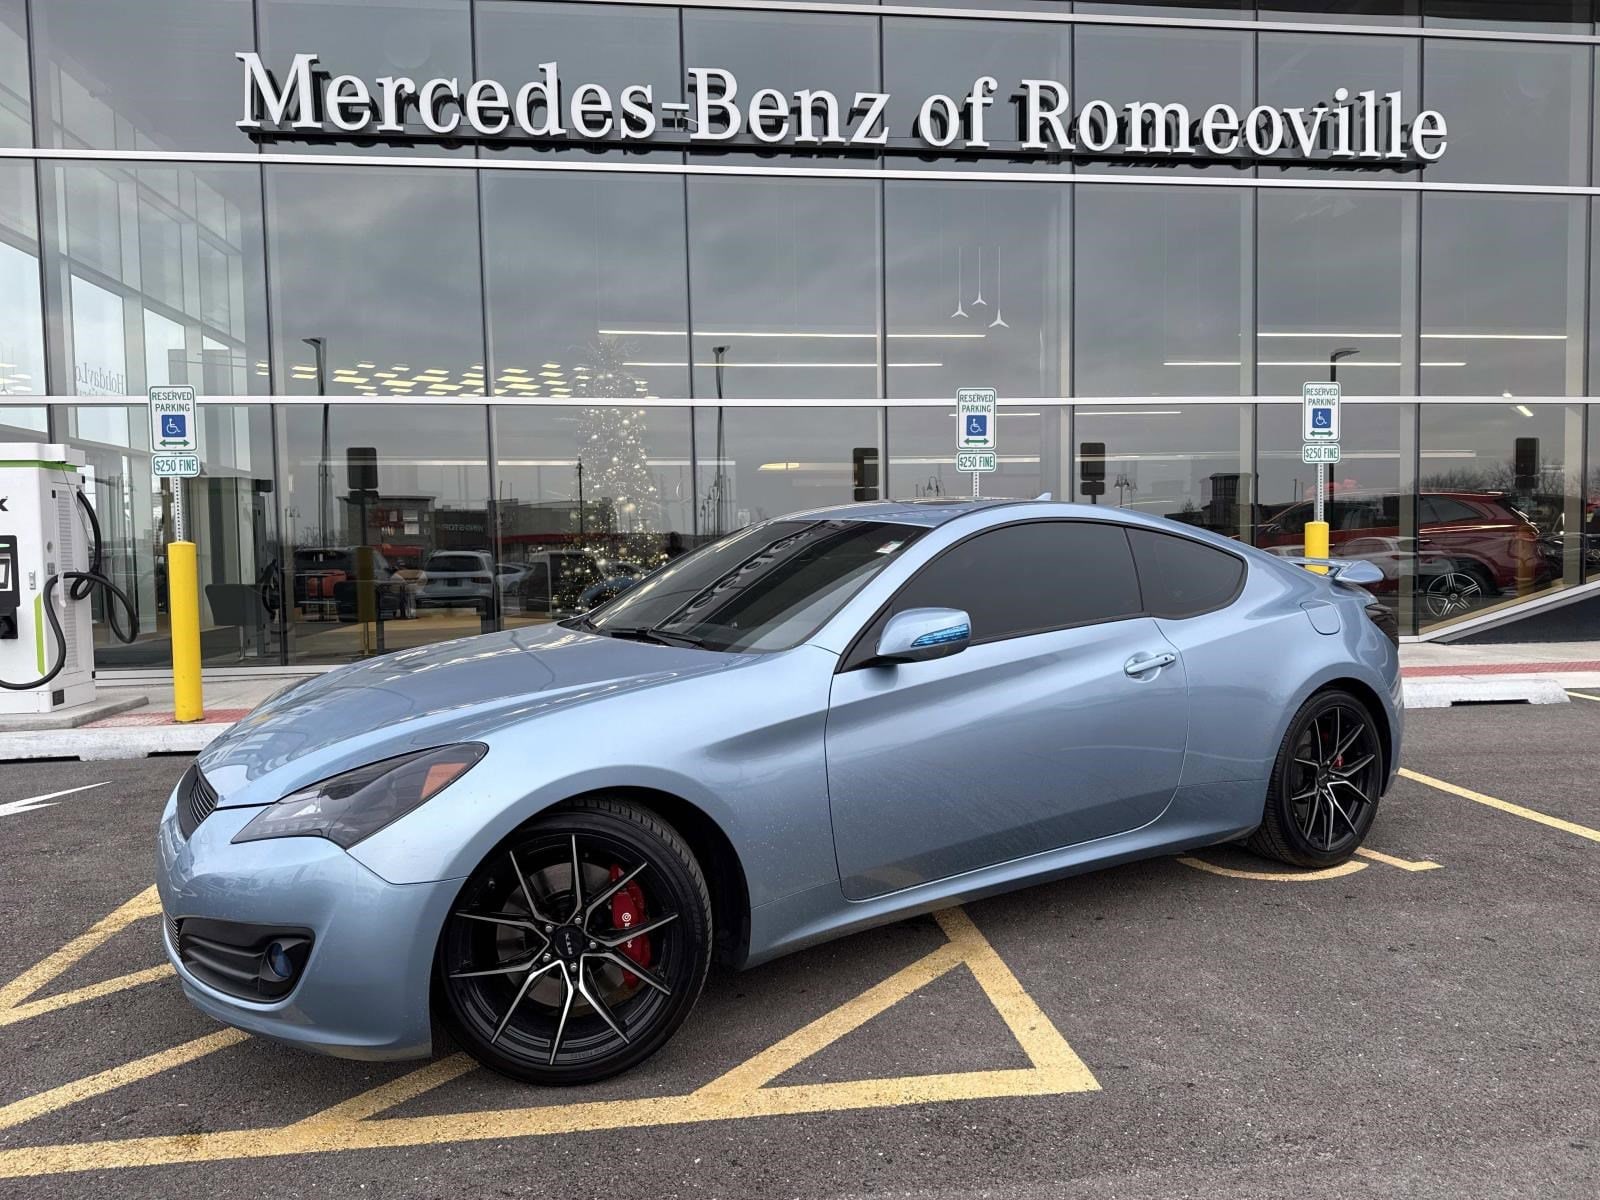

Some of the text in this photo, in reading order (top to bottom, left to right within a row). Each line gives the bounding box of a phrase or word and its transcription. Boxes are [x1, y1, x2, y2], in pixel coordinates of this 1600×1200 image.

[234, 51, 1448, 160] Mercedes-Benz of Romeoville
[151, 391, 193, 401] RESERVED
[1306, 388, 1338, 396] RESERVED
[959, 394, 994, 403] RESERVED
[1308, 398, 1336, 406] PARKING
[155, 403, 191, 412] PARKING
[961, 404, 992, 413] PARKING
[1305, 447, 1338, 459] $250 FINE
[155, 459, 196, 472] $250 FINE
[959, 456, 994, 468] $250 FINE
